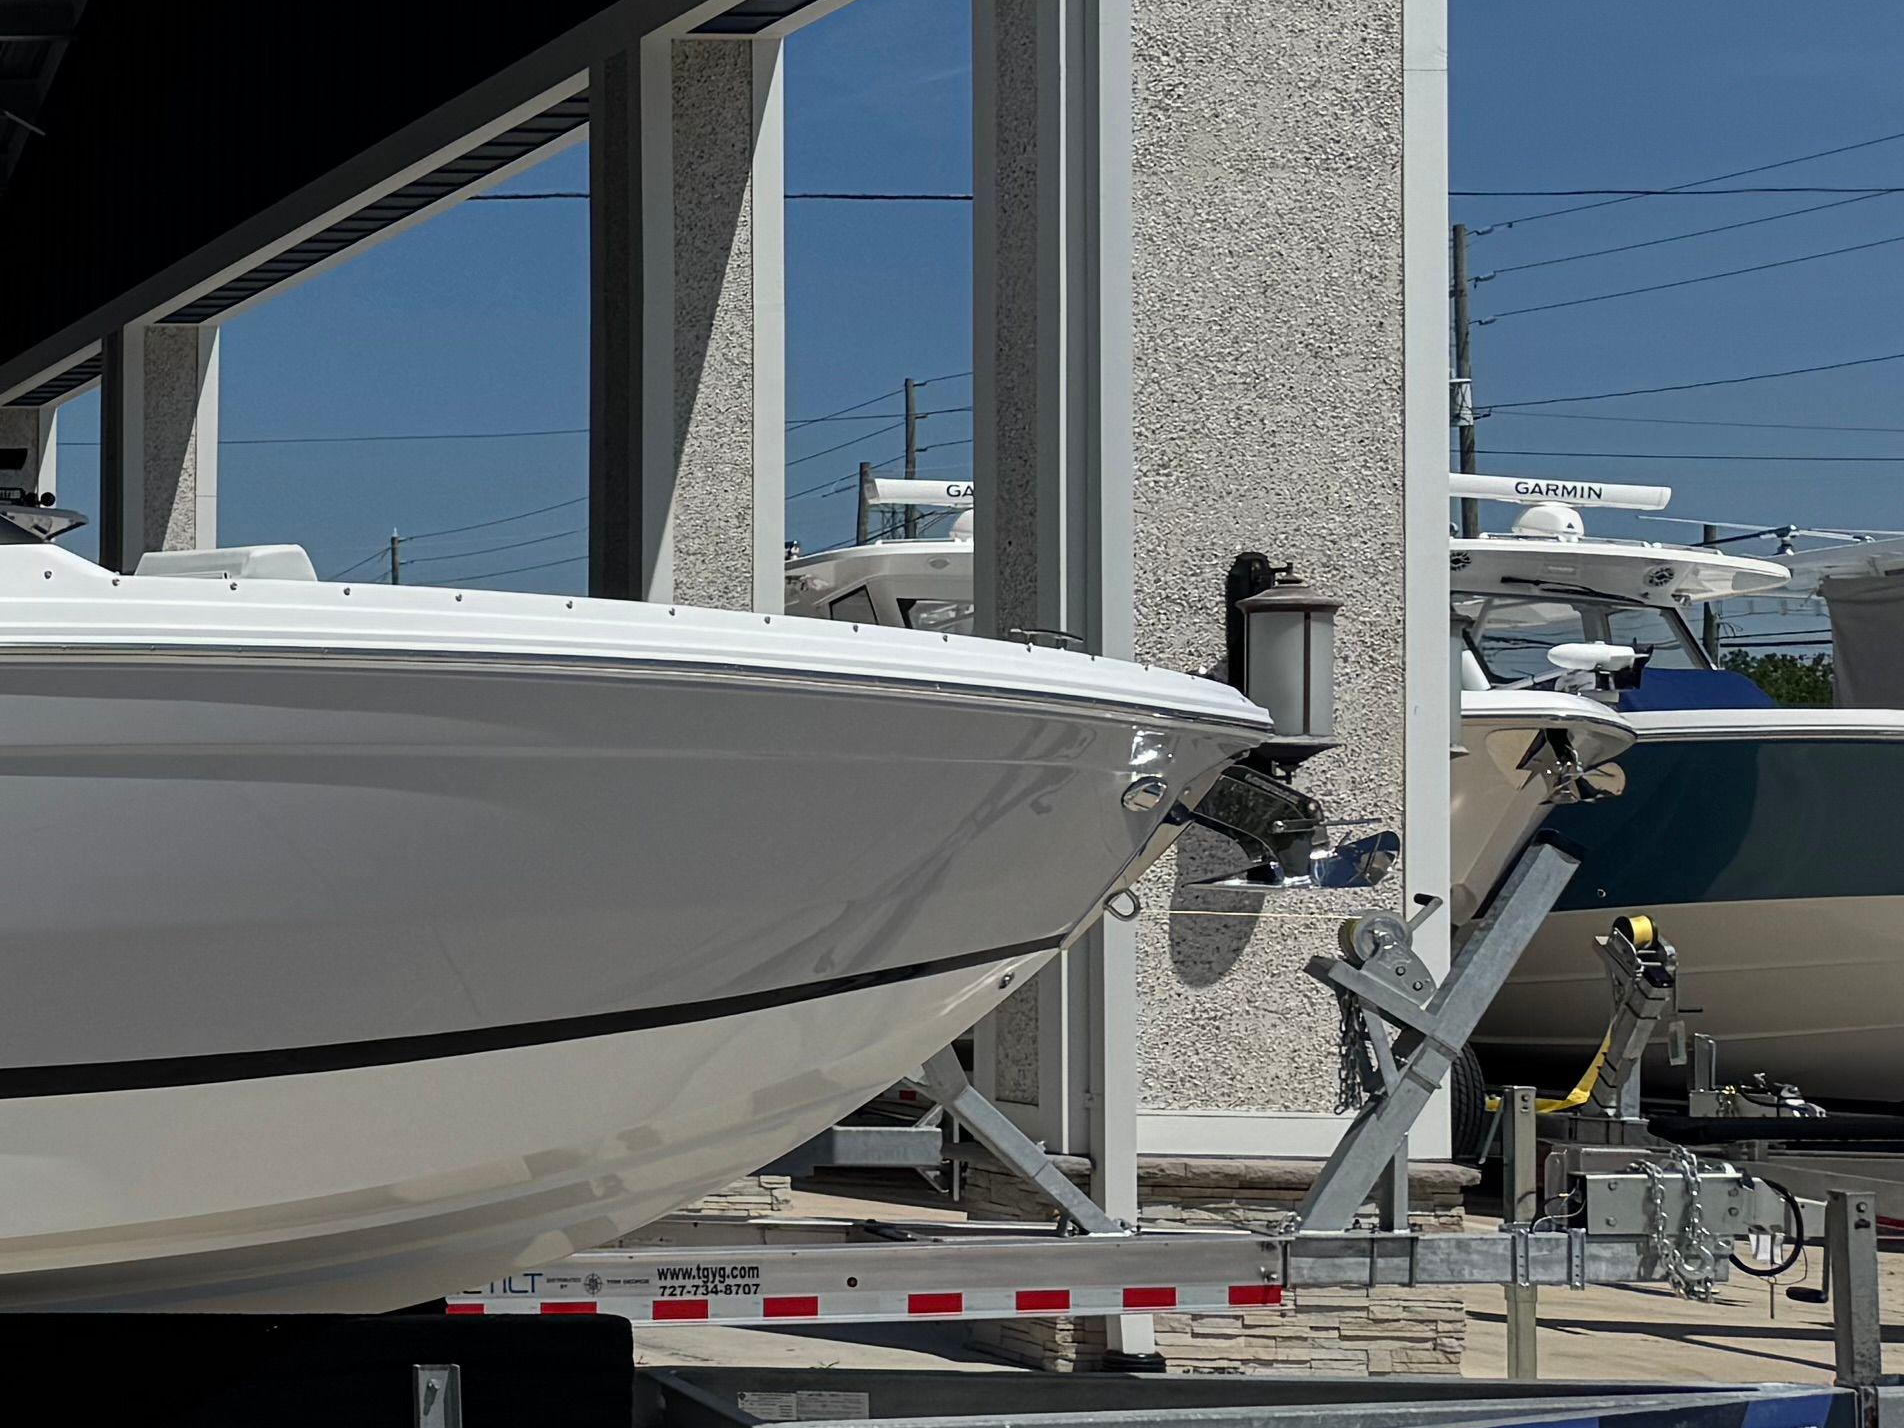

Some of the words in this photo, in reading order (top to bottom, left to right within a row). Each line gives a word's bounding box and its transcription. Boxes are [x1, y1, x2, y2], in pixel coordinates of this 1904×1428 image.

[1514, 481, 1603, 500] GARMIN
[656, 1263, 760, 1284] www.tgyg.com
[658, 1283, 761, 1297] 727-734-8707
